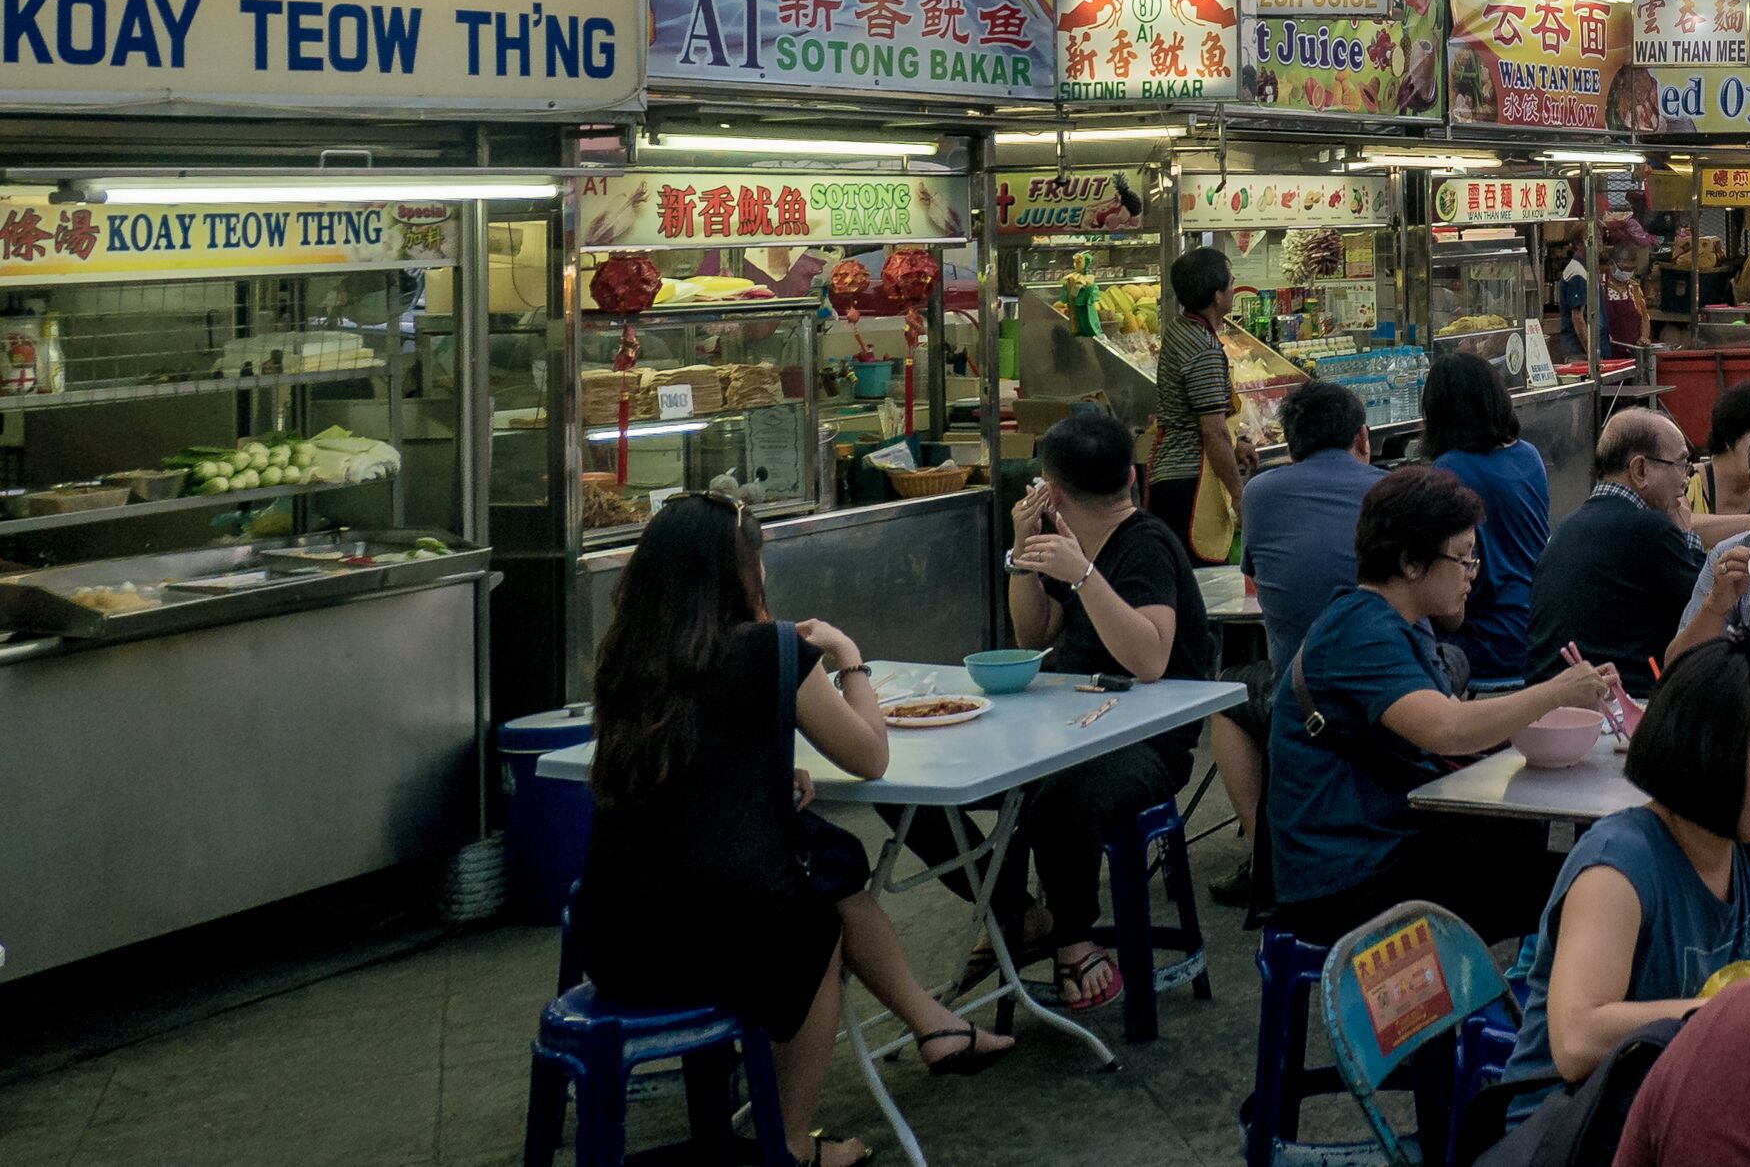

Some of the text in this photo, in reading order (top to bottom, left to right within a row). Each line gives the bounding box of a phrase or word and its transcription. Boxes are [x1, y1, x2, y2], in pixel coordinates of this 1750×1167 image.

[455, 2, 616, 80] TH'NG
[1136, 24, 1154, 43] A1
[1277, 21, 1365, 72] Juice
[776, 37, 1033, 87] SOTONG BAKAR
[1635, 40, 1746, 62] WAN THAN MEE
[1060, 79, 1204, 101] SOTONG BAKAR
[1498, 61, 1601, 95] WAN TAN MEE
[1543, 94, 1599, 127] Sui Kow
[583, 178, 608, 196] A1
[810, 183, 912, 210] SOTONG
[1028, 174, 1109, 201] FRUIT
[1555, 188, 1567, 210] 85
[1705, 190, 1728, 198] FRIED
[397, 203, 447, 220] Special
[656, 184, 810, 238] 新香魷魚
[831, 208, 913, 236] BAKAR
[1016, 206, 1084, 227] JUICE
[1467, 212, 1483, 221] WAN
[1483, 211, 1499, 220] THAN
[1500, 210, 1512, 220] MEE
[1522, 210, 1531, 219] SUI
[1531, 209, 1545, 219] KOW
[107, 210, 383, 252] KOAY TEOW TH'NG
